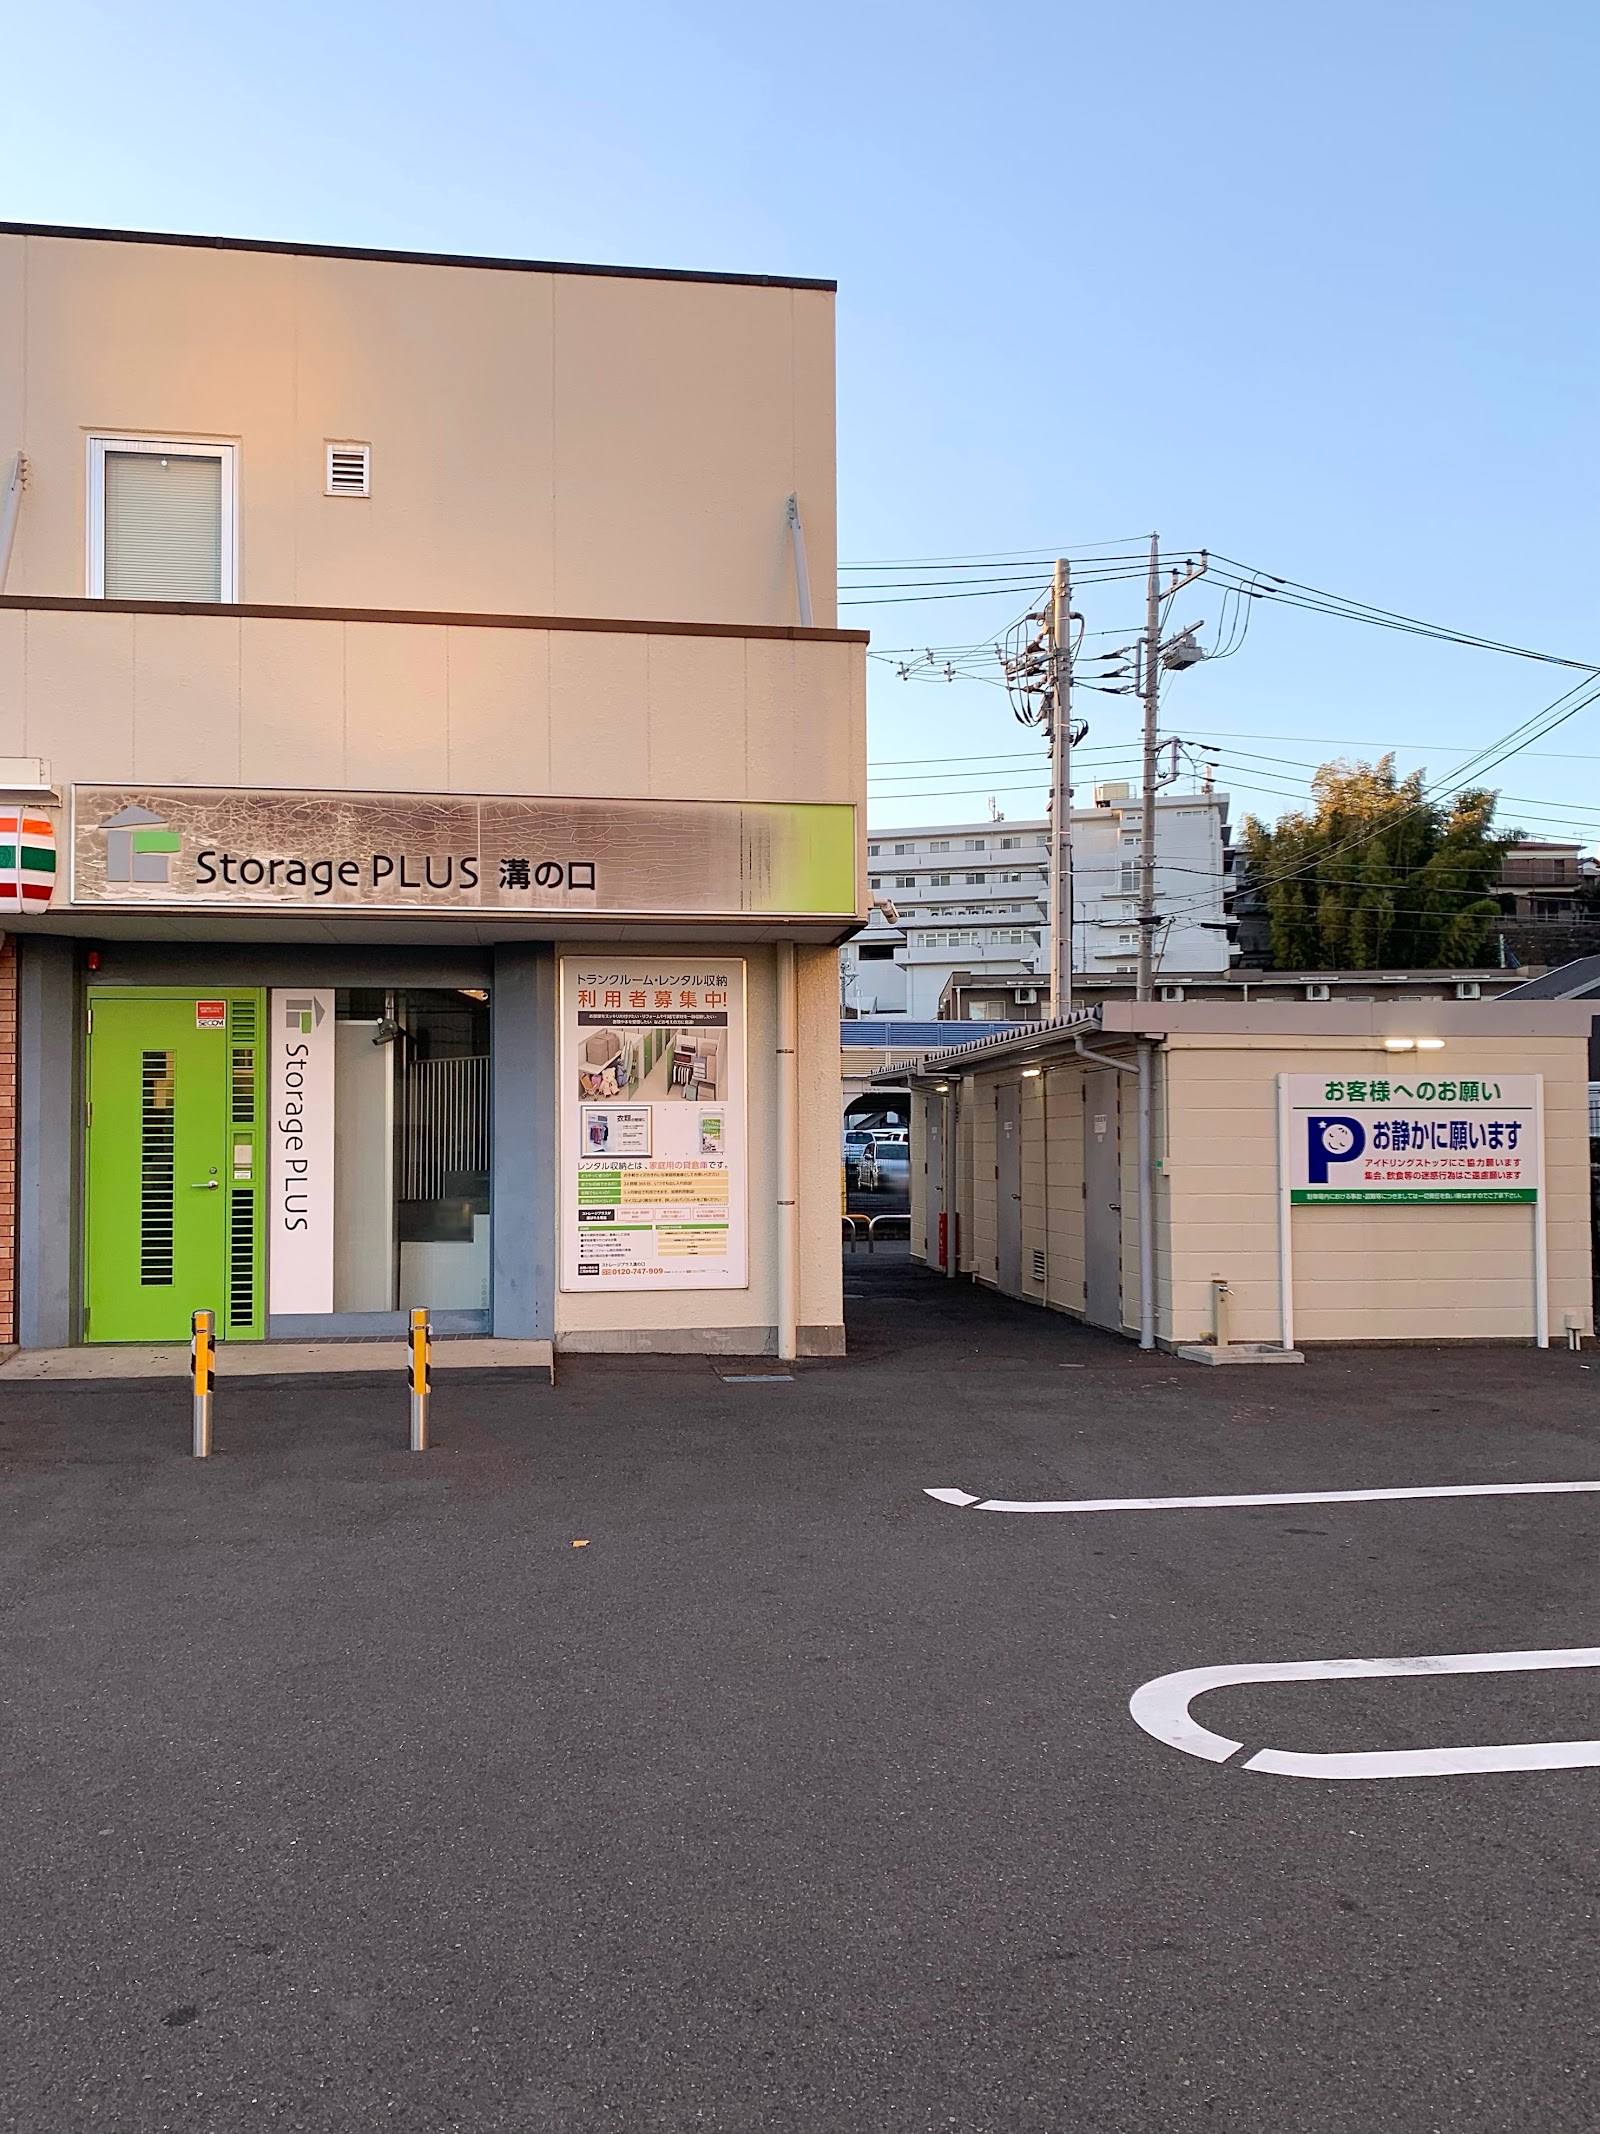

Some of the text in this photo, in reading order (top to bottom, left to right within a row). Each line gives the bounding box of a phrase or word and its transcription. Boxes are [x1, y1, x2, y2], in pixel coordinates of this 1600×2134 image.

[196, 851, 596, 896] Storage PLUS 溝の口
[577, 974, 728, 987] トランクルーム・レンタル収納
[198, 1019, 224, 1027] SECOM
[1324, 1080, 1502, 1102] お客様へのお願い
[278, 1043, 309, 1232] Storage PLUS
[1372, 1120, 1522, 1151] お静かに願います
[1365, 1158, 1521, 1168] アイドリングストップにご協力願います
[1364, 1170, 1521, 1180] 集会、飲食等の迷惑行為はご遠慮願います
[612, 1268, 664, 1276] 0120-747-909
